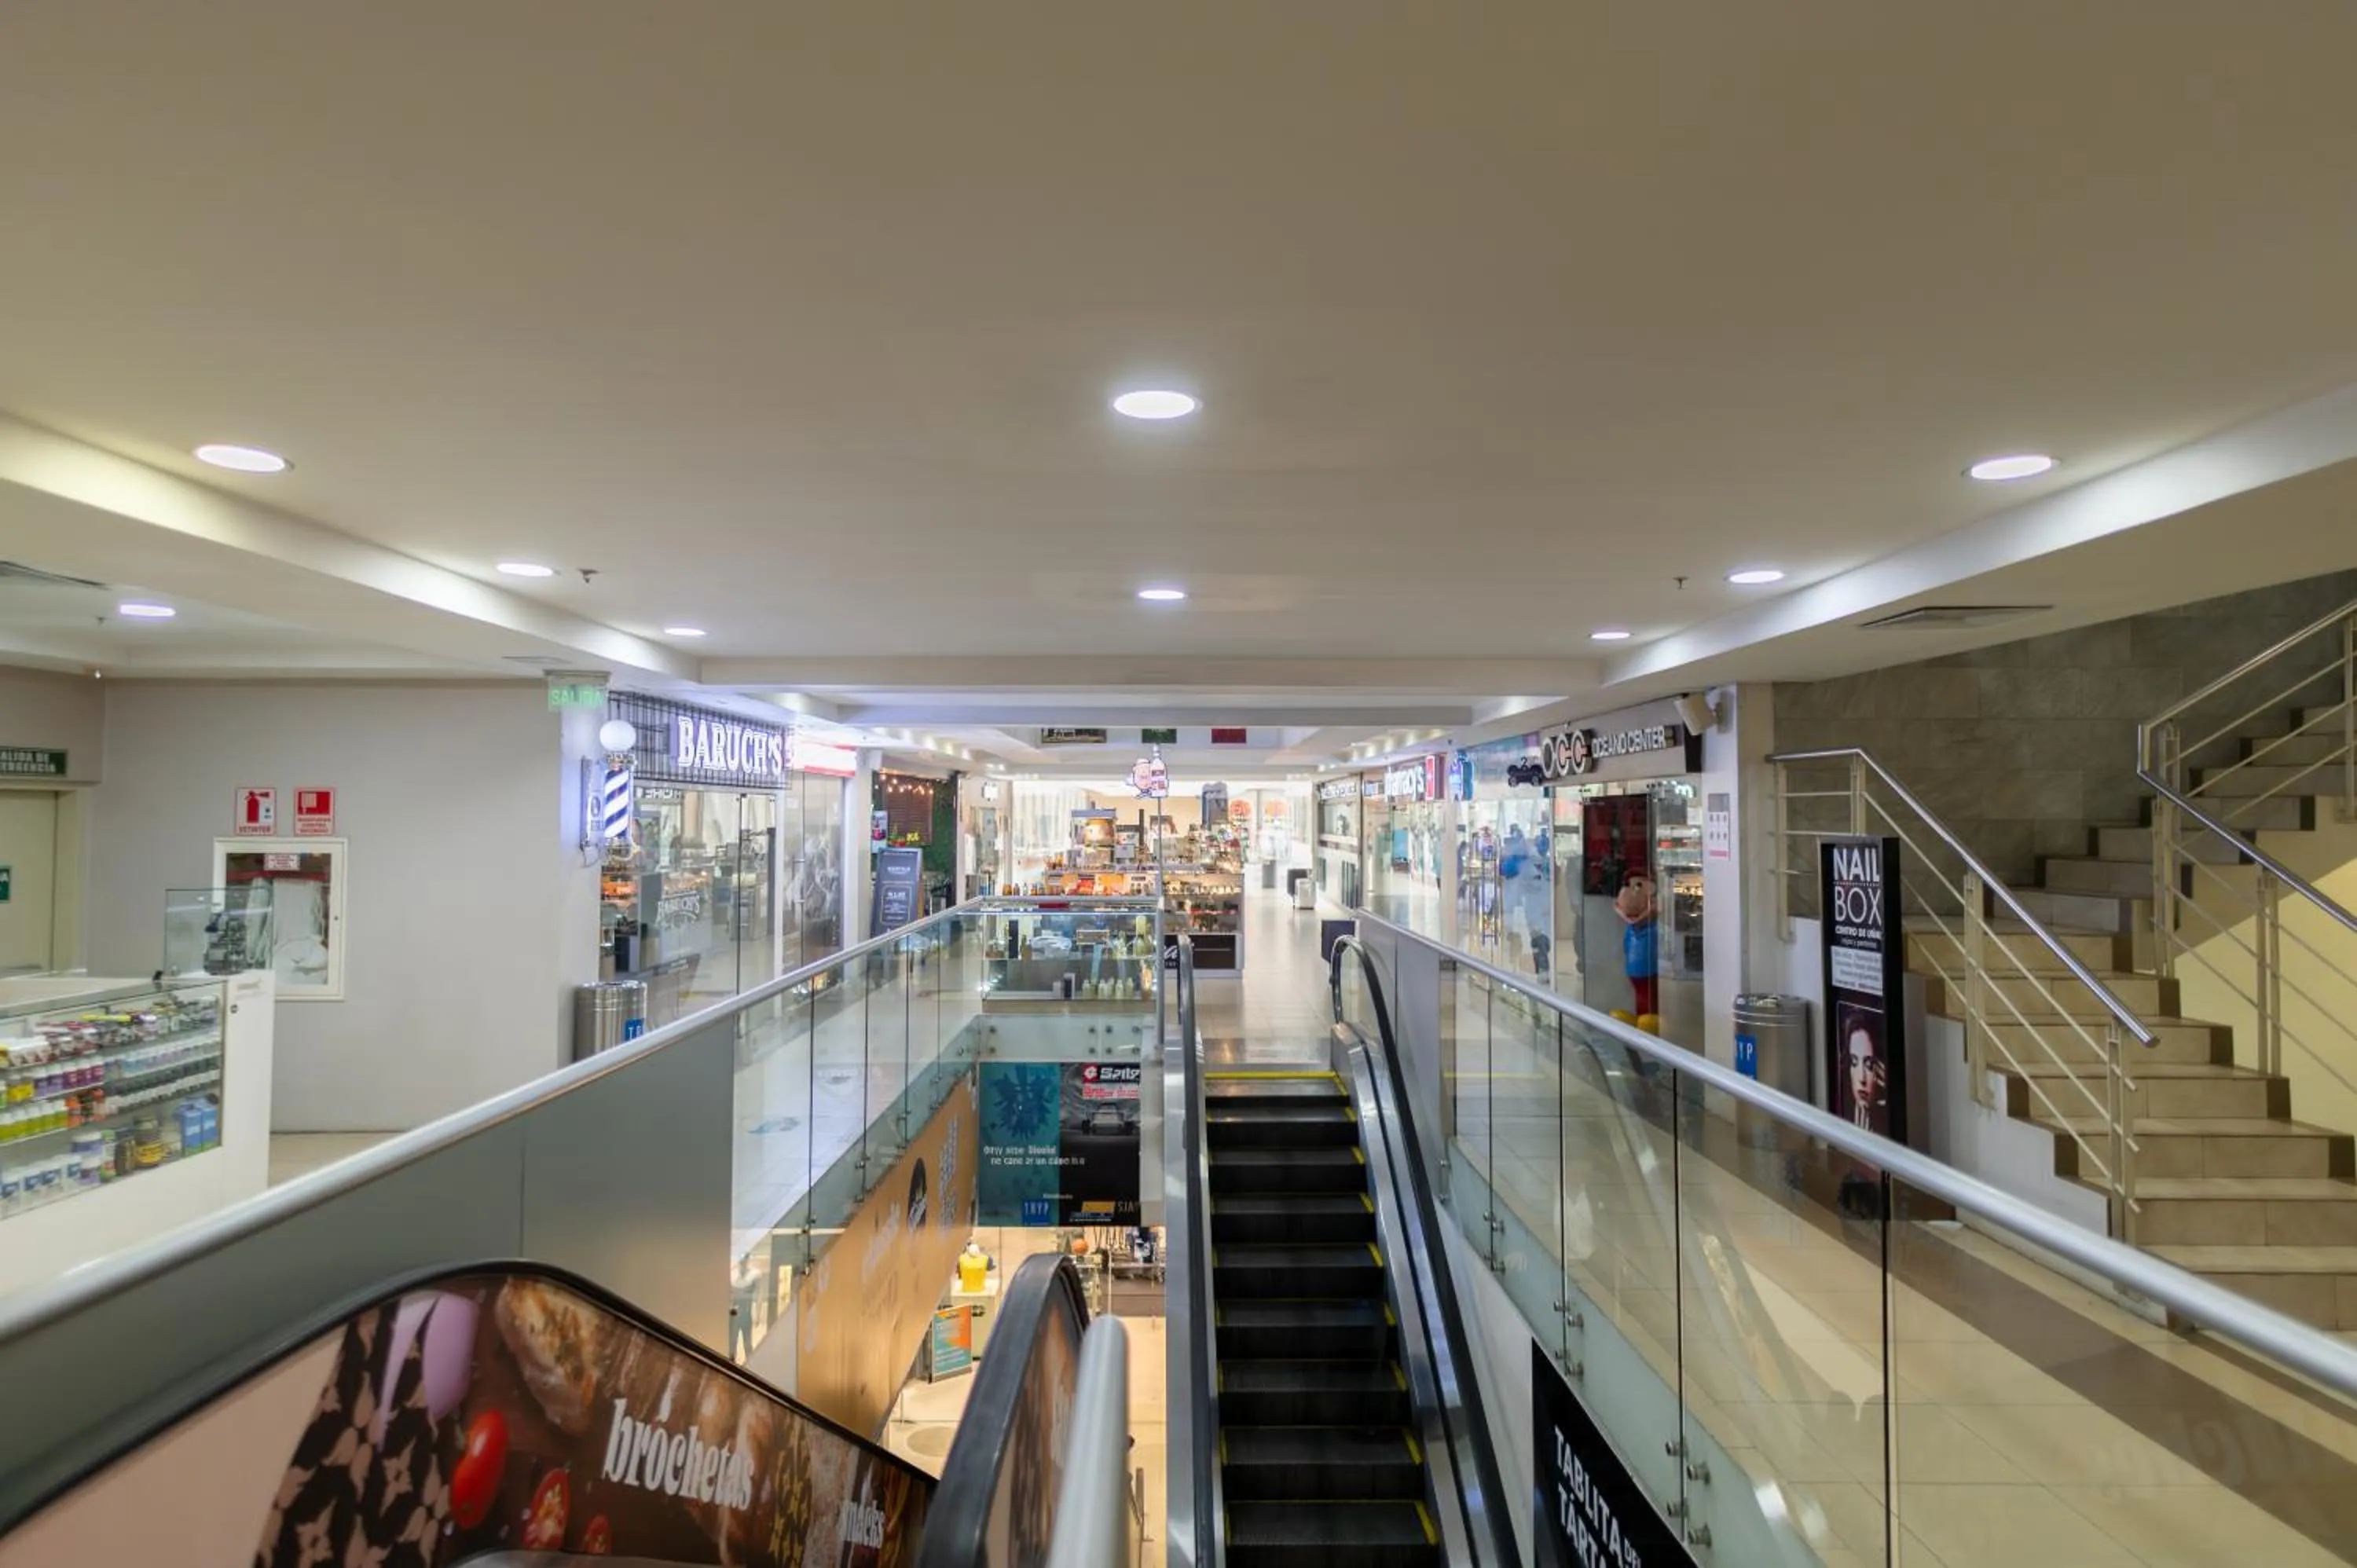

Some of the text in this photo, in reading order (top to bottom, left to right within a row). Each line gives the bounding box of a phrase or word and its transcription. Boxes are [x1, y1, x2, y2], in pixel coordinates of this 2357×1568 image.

[678, 716, 783, 775] BARUCH'S
[1627, 724, 1666, 753] CENTER
[1833, 848, 1880, 882] NAIL
[1835, 885, 1882, 926] BOX
[603, 1398, 754, 1511] brochetas
[1555, 1423, 1624, 1568] TABLITA
